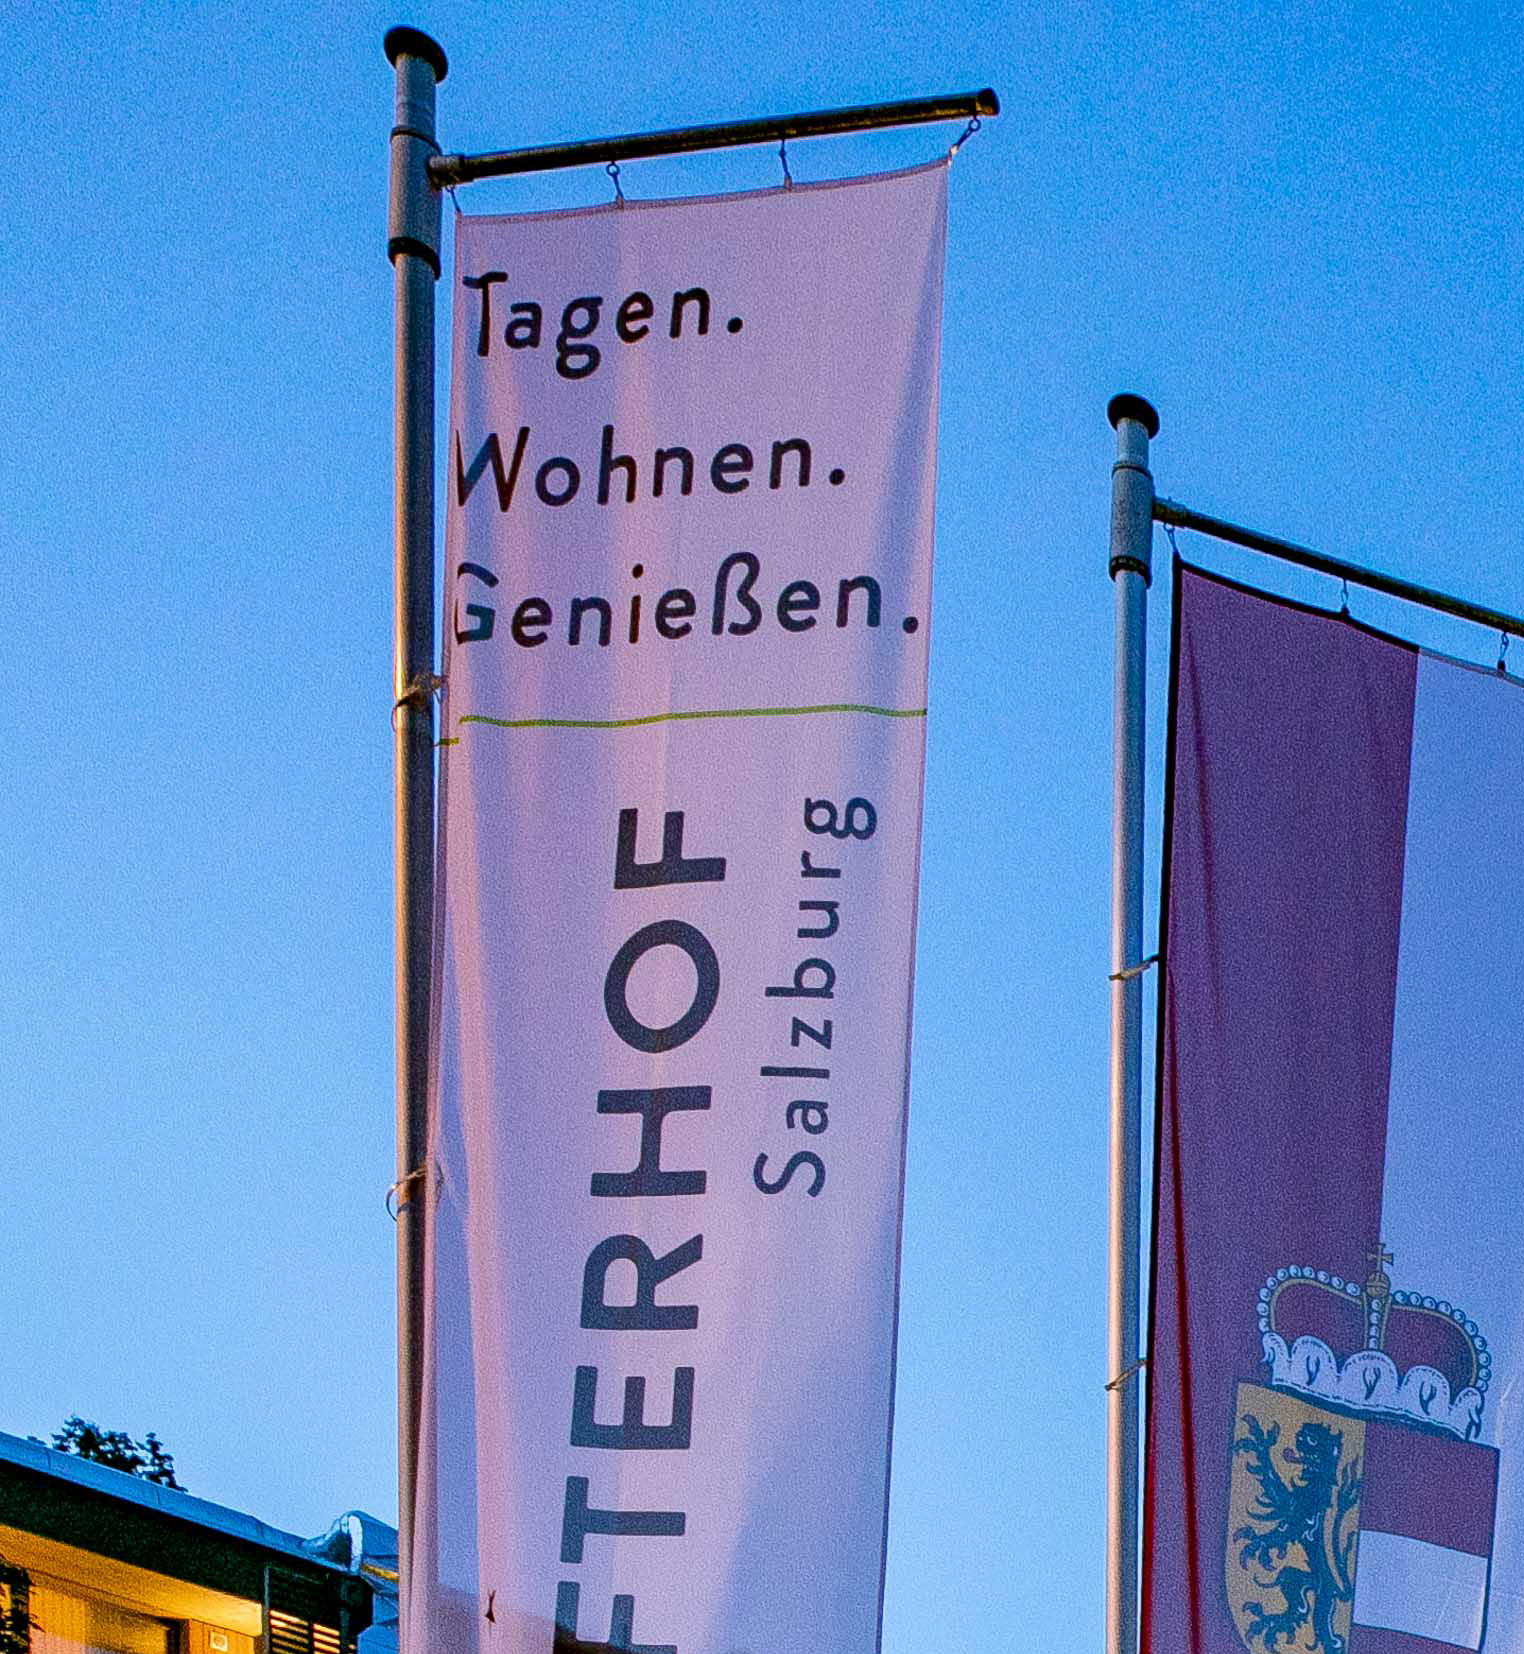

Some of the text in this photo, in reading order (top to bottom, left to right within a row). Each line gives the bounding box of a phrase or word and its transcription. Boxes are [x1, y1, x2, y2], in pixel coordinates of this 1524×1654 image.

[462, 271, 744, 379] Tagen.
[455, 424, 846, 513] Wohnen.
[455, 551, 920, 648] Genießen.
[752, 796, 878, 1198] Salzburg
